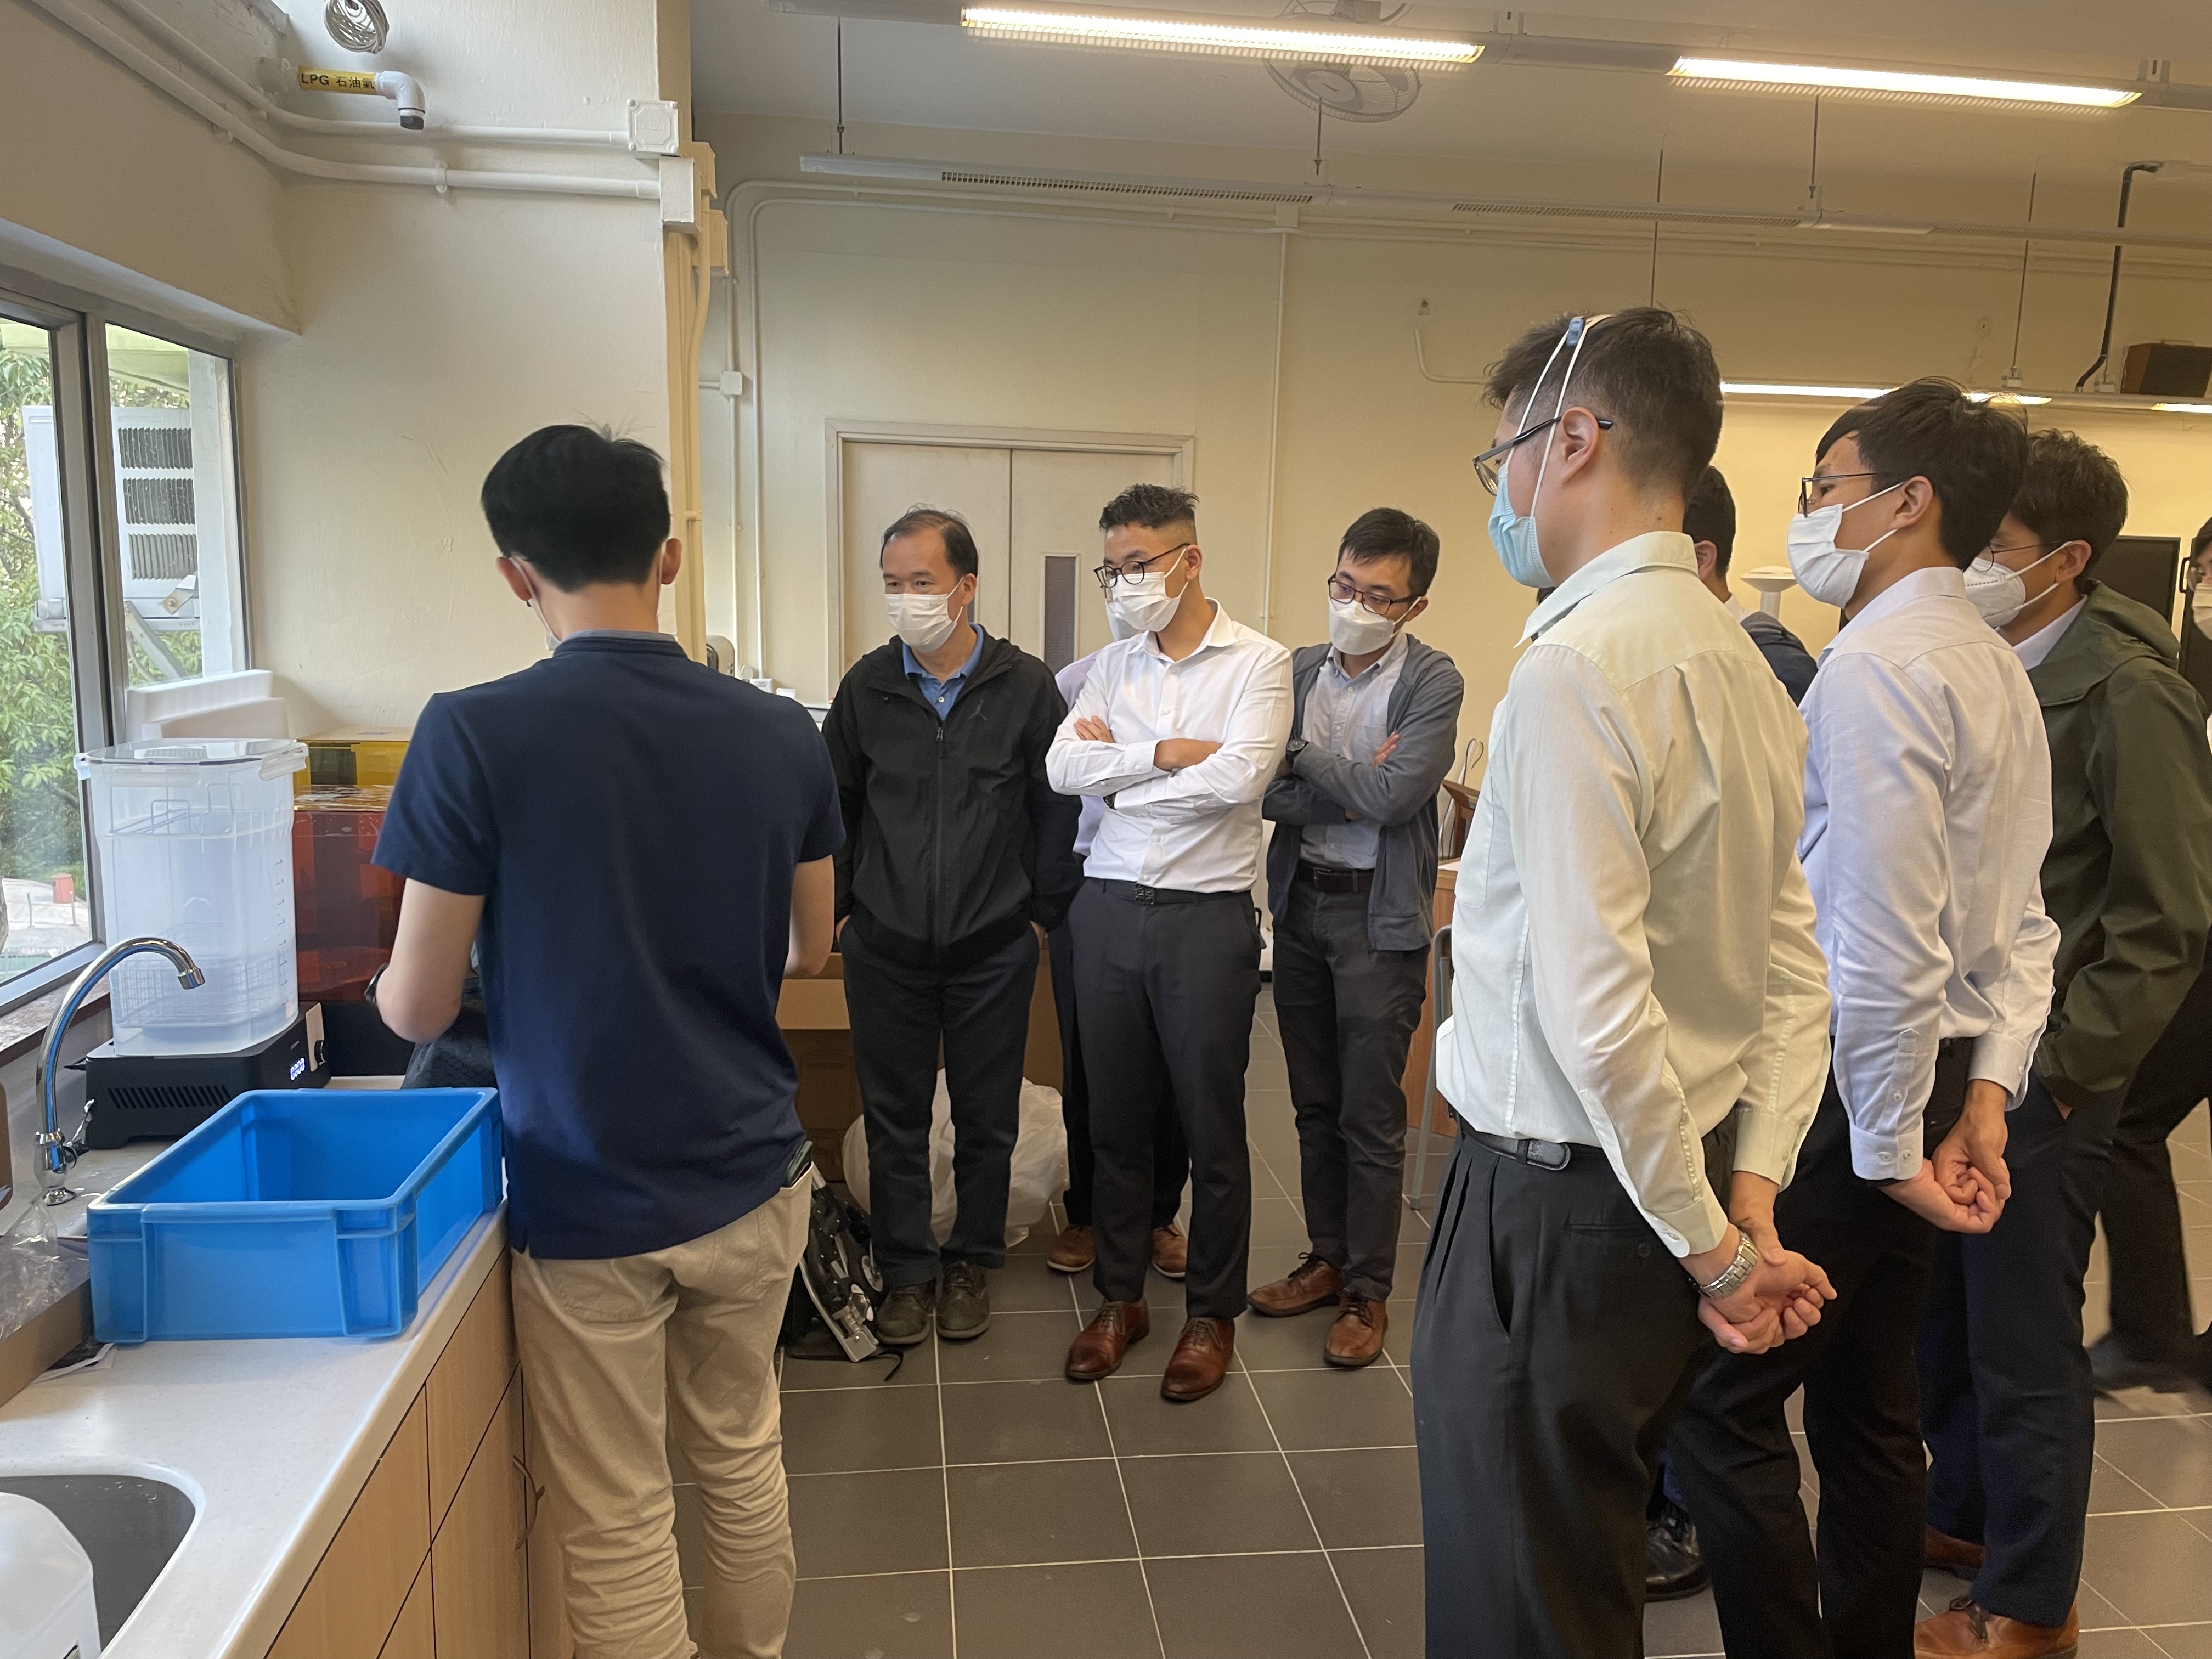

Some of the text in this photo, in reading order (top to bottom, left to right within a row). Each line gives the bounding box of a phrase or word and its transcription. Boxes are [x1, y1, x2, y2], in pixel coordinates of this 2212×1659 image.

[302, 74, 375, 89] LPG 石油氣
